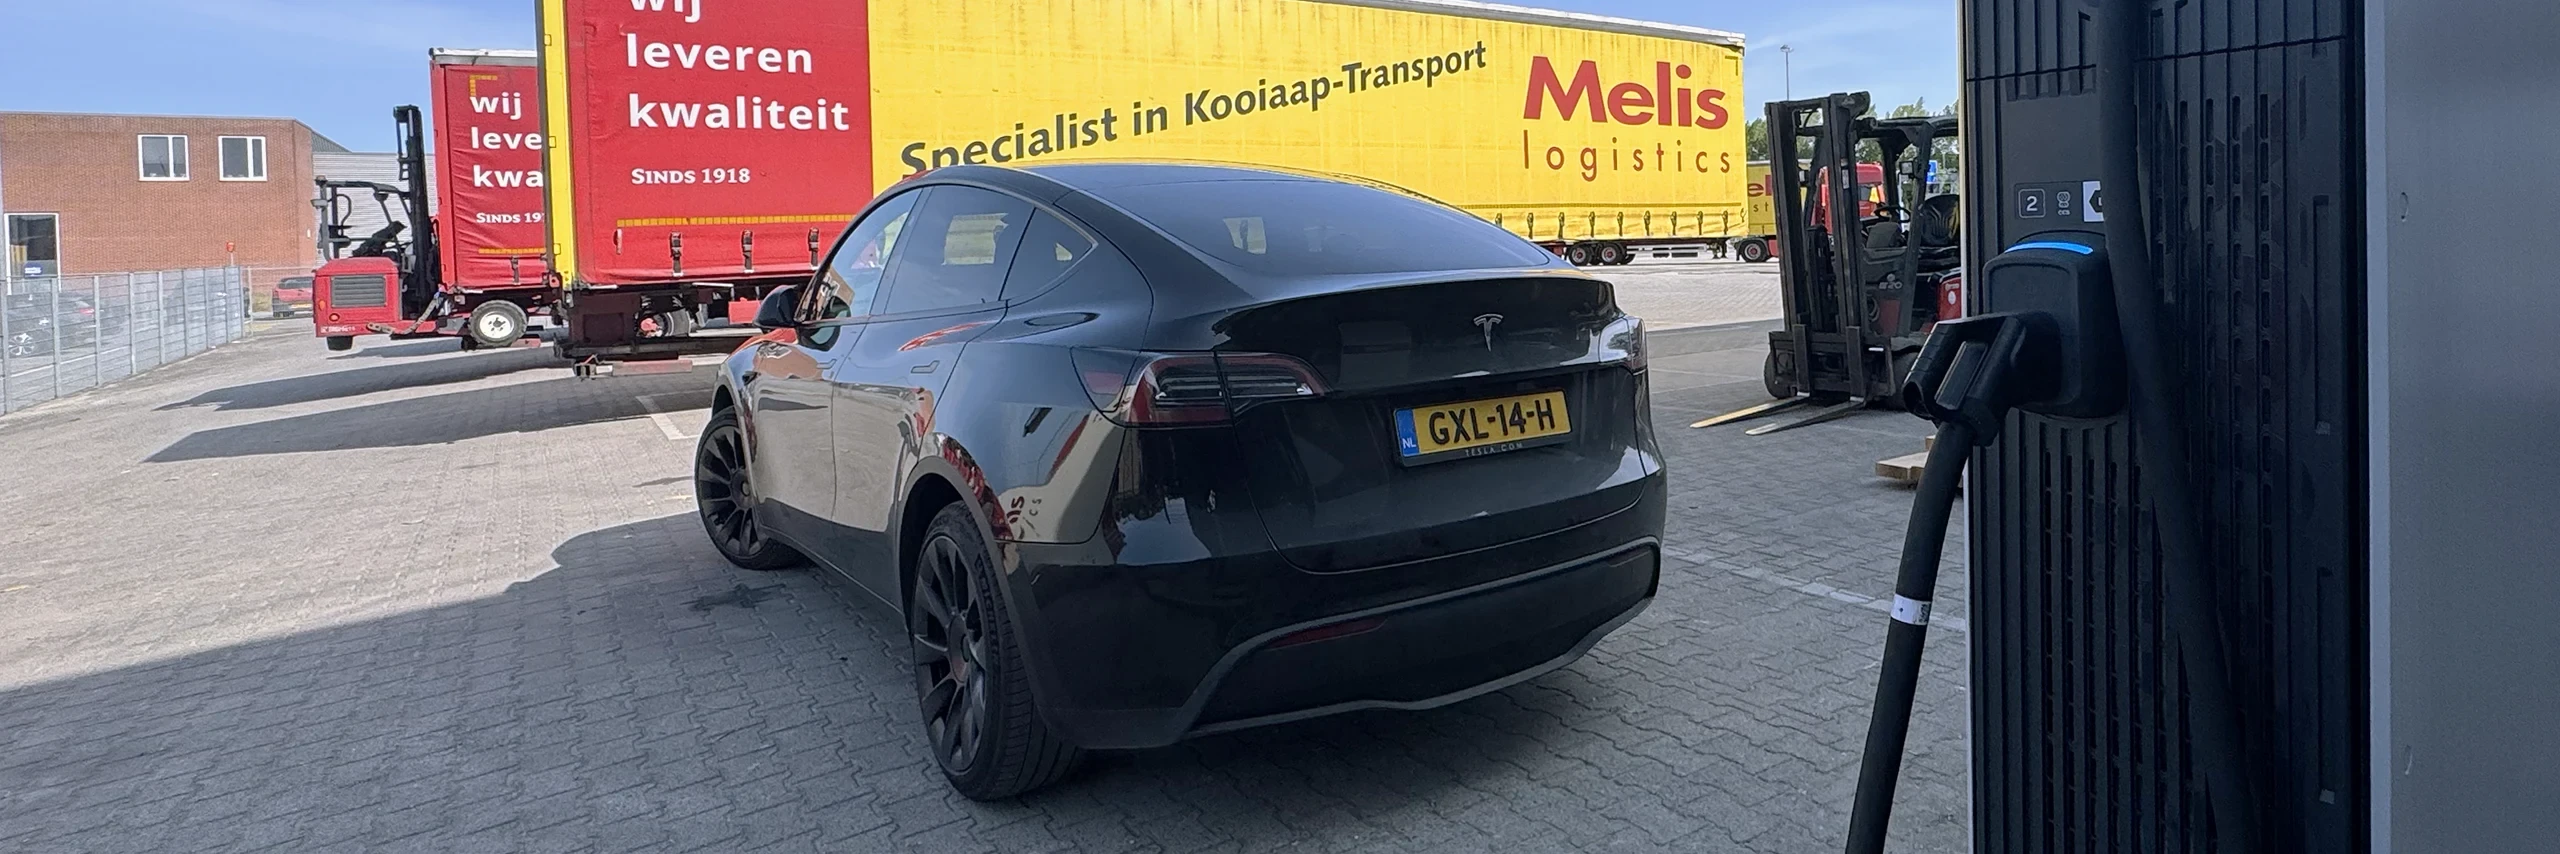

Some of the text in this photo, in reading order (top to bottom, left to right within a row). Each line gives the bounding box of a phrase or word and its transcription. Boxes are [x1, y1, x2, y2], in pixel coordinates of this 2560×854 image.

[627, 33, 812, 73] leveren
[470, 92, 522, 120] wij
[1133, 101, 1168, 136] in
[1185, 40, 1487, 126] Kooiaap-Transport
[1523, 56, 1729, 130] Melis
[629, 93, 850, 130] kwaliteit
[1523, 130, 1731, 182] logistics
[702, 168, 751, 183] 1918
[2026, 196, 2038, 211] 2
[1428, 398, 1556, 445] GXL-14-H
[1402, 437, 1416, 448] NL
